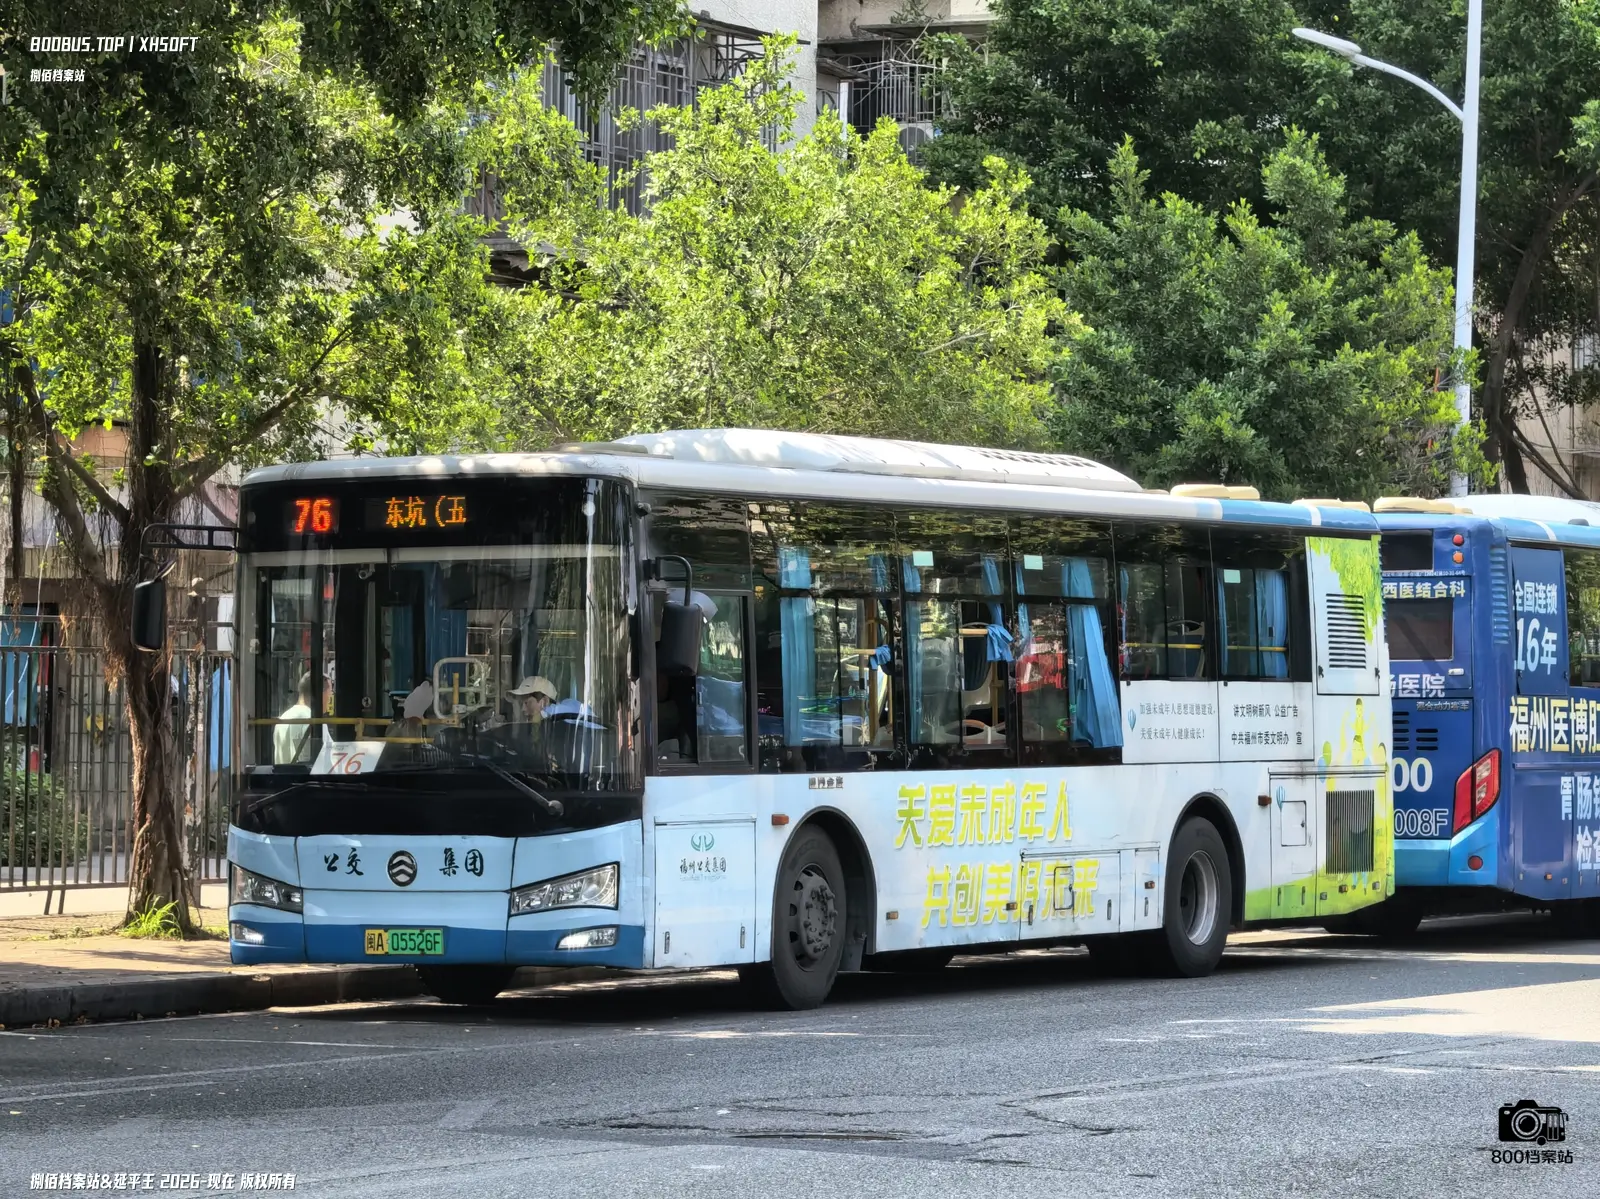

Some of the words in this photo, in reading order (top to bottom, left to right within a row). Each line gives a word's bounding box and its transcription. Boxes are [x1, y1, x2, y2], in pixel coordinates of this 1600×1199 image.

[295, 498, 332, 533] 76
[1382, 580, 1466, 599] 西医结合科
[1512, 579, 1558, 615] 全国连锁
[1233, 703, 1272, 718] 讲文明树新风
[1273, 703, 1299, 718] 公益广告
[1231, 730, 1290, 746] 中共福州市委文明办
[1295, 731, 1303, 745] 宣
[328, 752, 365, 775] 76
[894, 779, 1073, 849] 关爱未成年人
[1393, 808, 1449, 836] 008F
[324, 847, 364, 876] 公交
[439, 847, 484, 877] 集团
